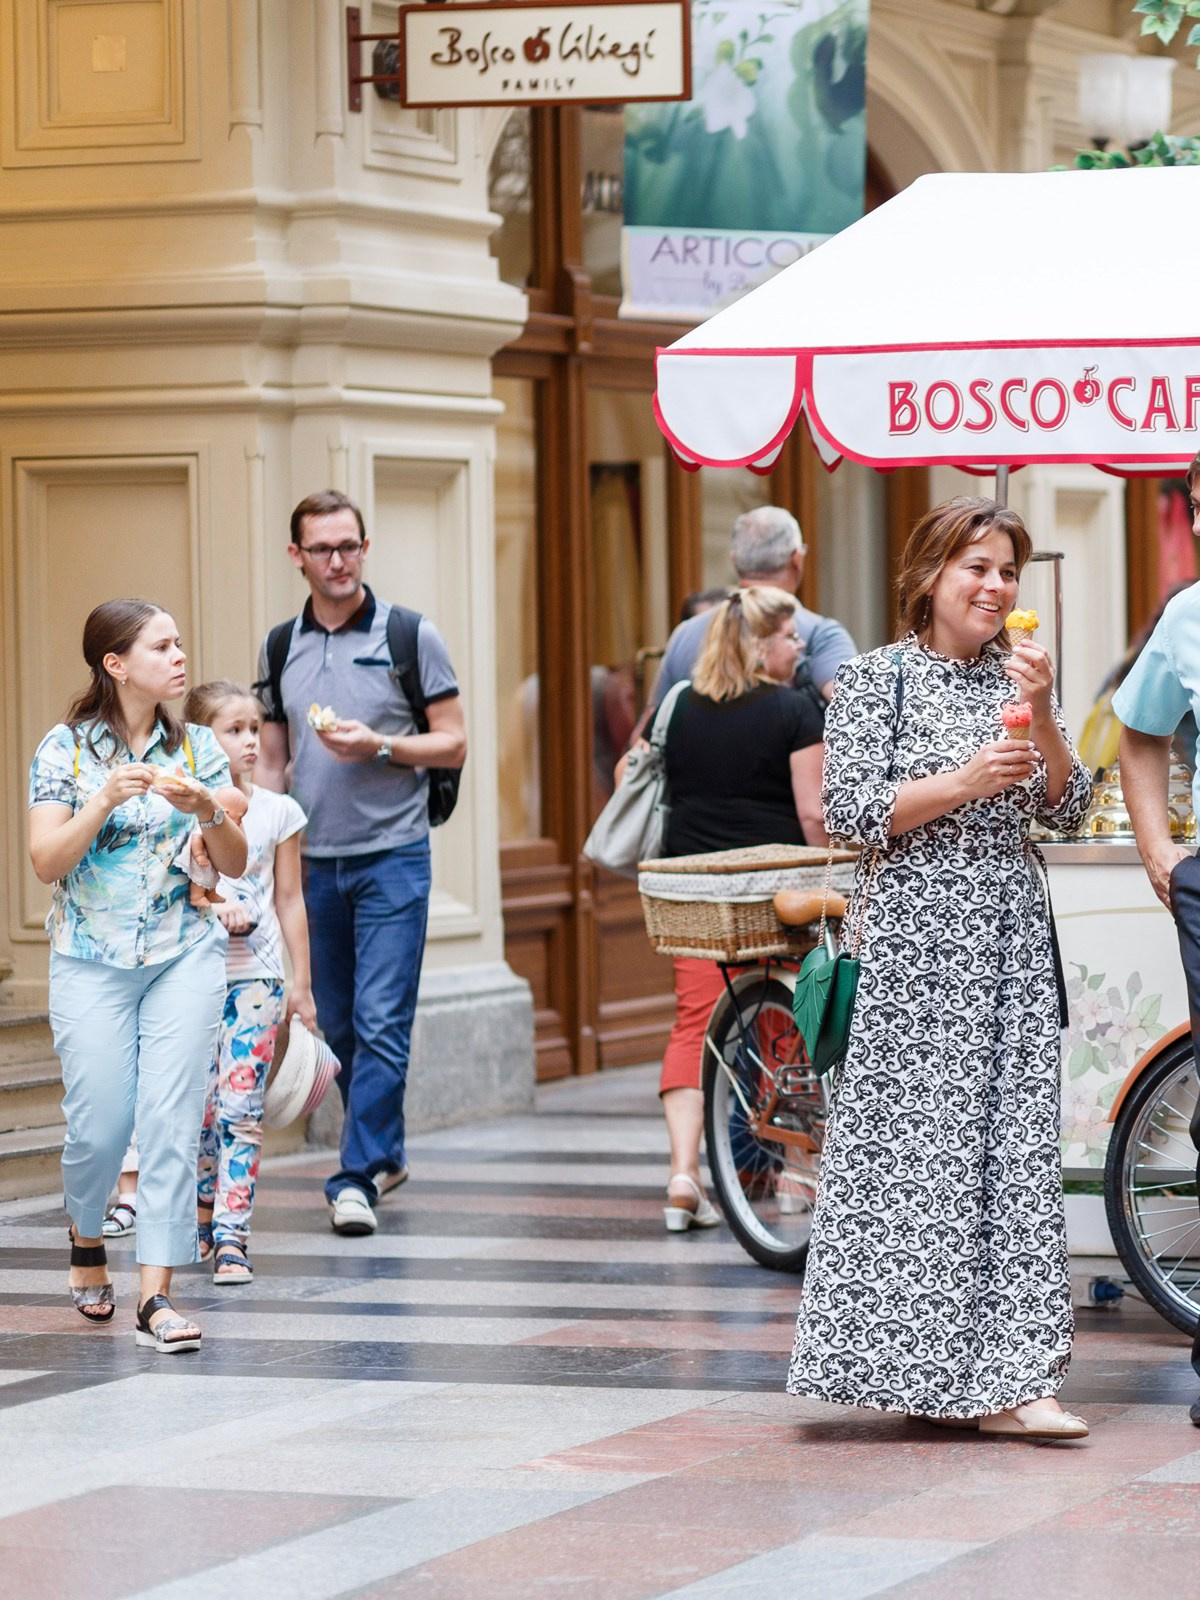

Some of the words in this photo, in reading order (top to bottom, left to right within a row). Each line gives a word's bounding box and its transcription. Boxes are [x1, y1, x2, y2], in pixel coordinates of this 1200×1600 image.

[431, 27, 516, 75] Bosco
[502, 76, 576, 92] FAMILY
[888, 377, 1069, 437] BOSCO
